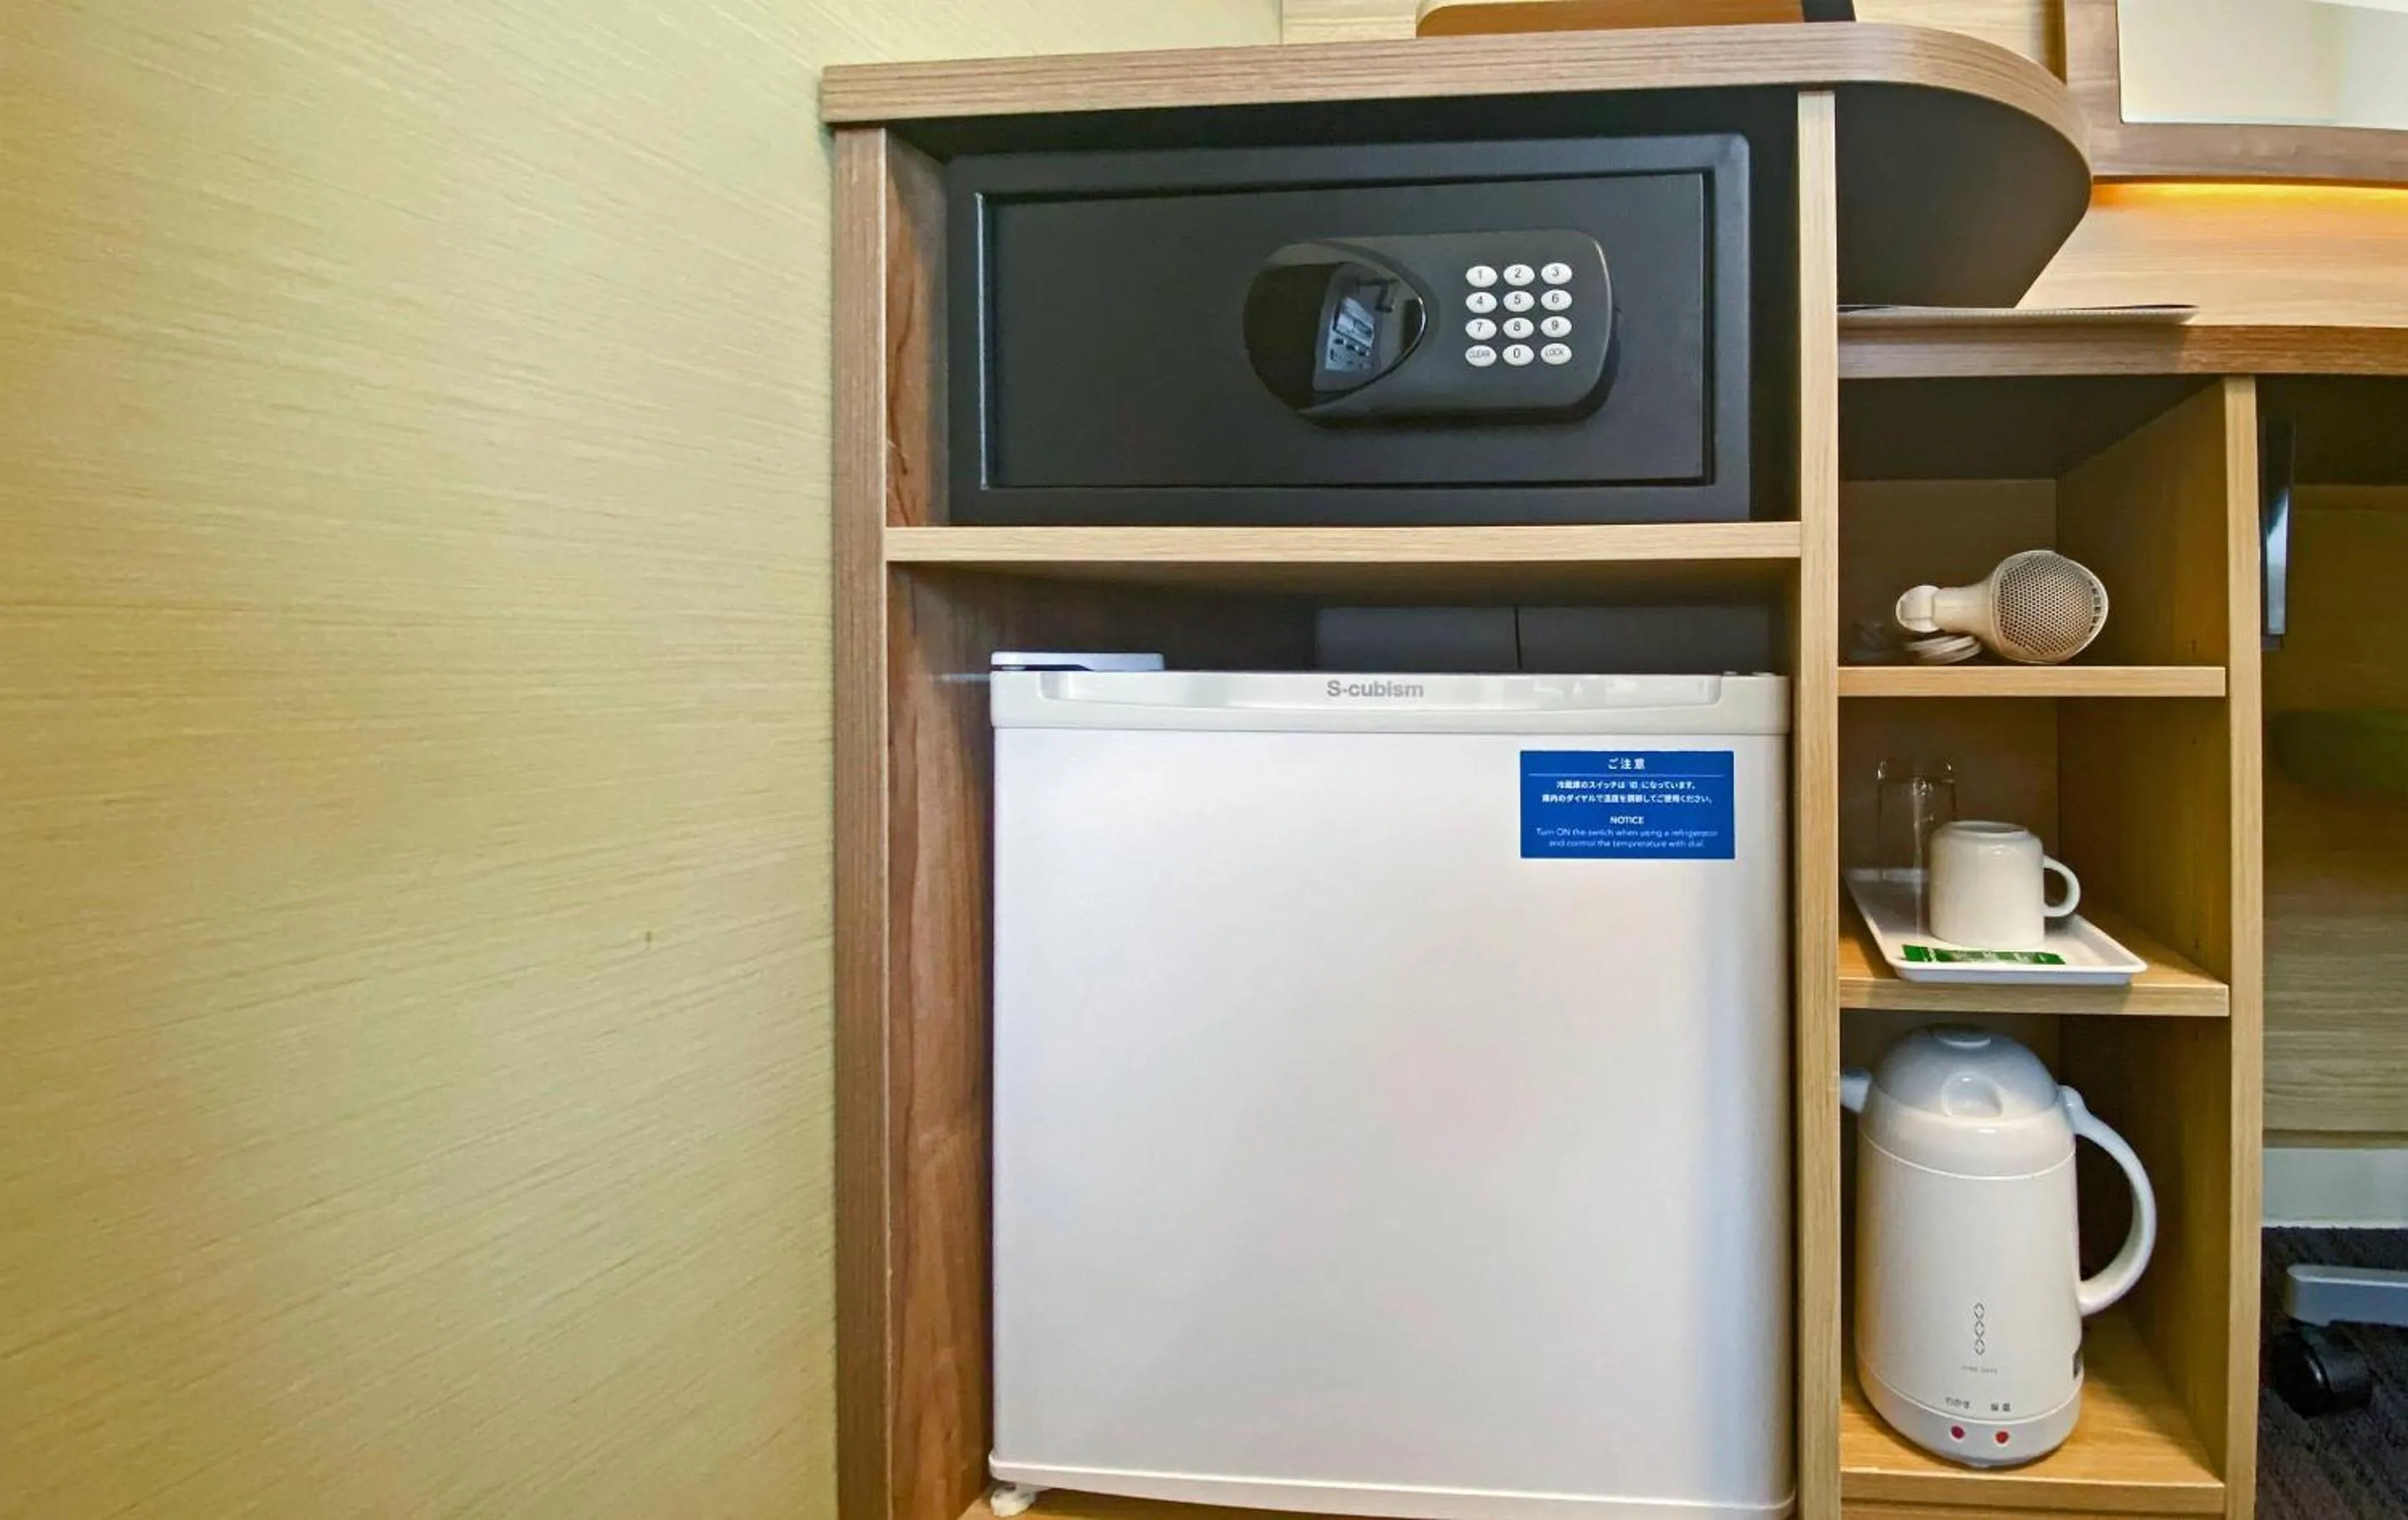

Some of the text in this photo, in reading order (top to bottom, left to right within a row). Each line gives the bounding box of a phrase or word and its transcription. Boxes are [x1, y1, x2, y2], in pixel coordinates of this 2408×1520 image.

[1514, 268, 1522, 279] 2
[1552, 266, 1559, 278] 3
[1476, 293, 1559, 306] 4 5 6
[1477, 319, 1559, 333] 7 8 9
[1608, 757, 1645, 769] ご注意
[1610, 816, 1644, 824] NOTICE
[1536, 827, 1554, 836] Turn
[1556, 828, 1570, 836] ON
[1573, 828, 1586, 836] the
[1589, 829, 1614, 837] switch
[1615, 829, 1638, 837] when
[1640, 829, 1662, 839] using
[1549, 839, 1565, 847] and
[1567, 839, 1596, 847] control
[1597, 839, 1610, 847] the
[1668, 839, 1686, 848] with
